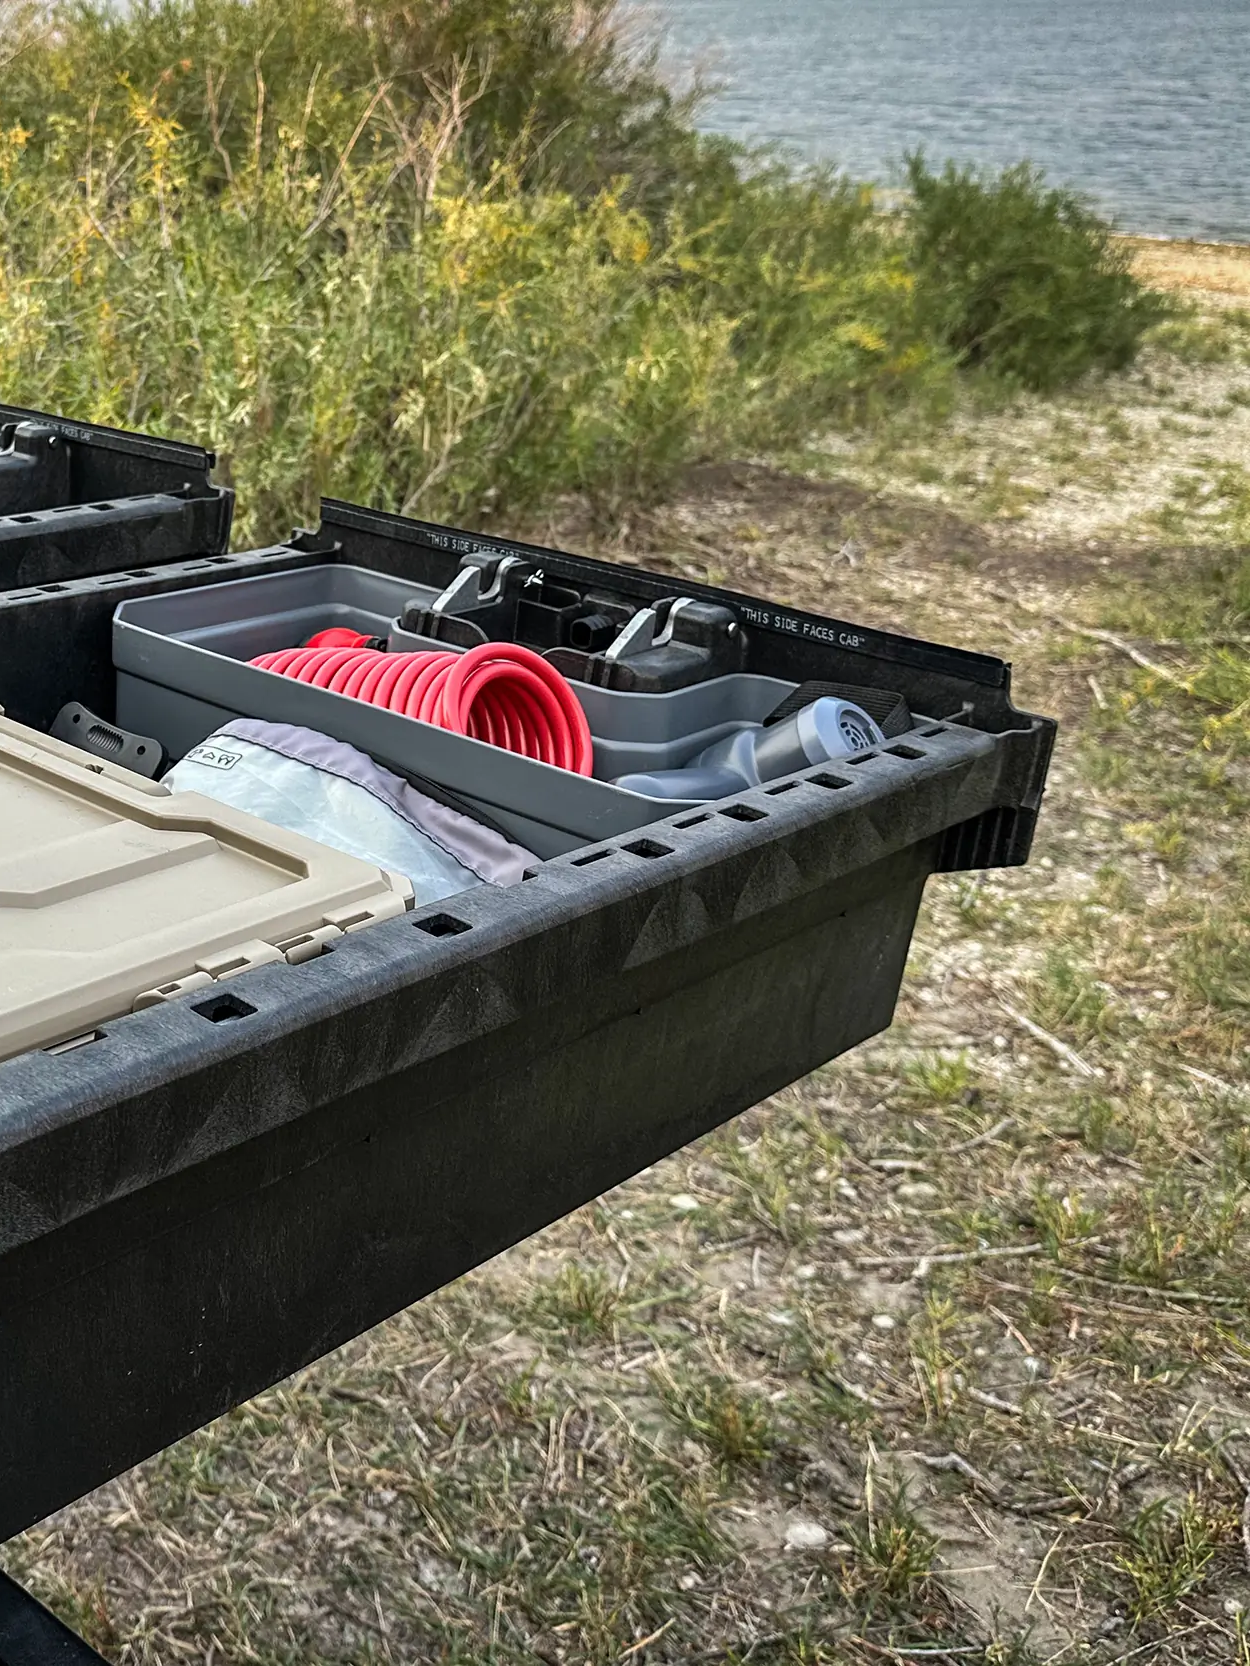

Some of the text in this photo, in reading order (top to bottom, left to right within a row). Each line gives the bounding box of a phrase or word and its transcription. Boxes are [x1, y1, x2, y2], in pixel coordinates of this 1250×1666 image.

[427, 533, 449, 548] "THIS
[452, 539, 470, 553] SIDE
[740, 606, 865, 647] "THIS SIDE FACES CAB"
